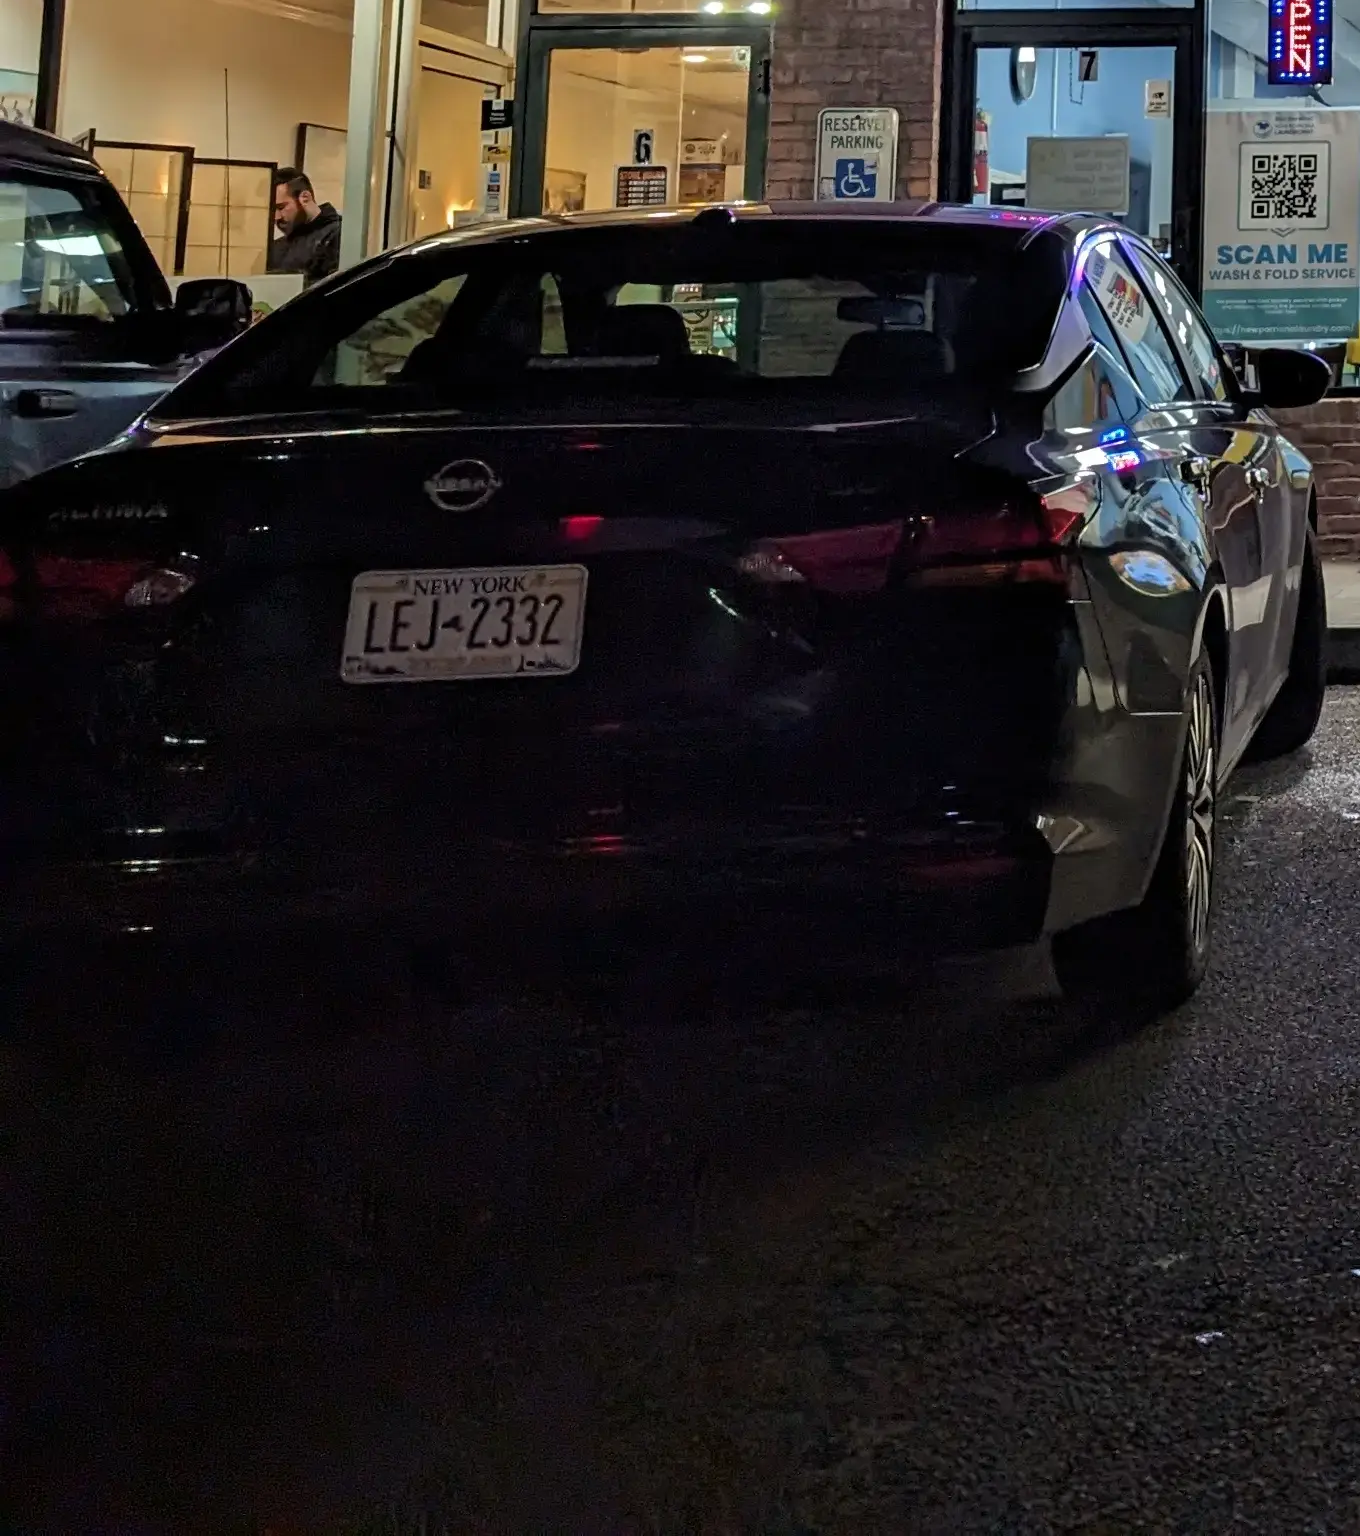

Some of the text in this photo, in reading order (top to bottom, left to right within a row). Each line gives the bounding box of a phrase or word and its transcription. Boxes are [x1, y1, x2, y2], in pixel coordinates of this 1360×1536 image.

[1081, 51, 1096, 81] 7
[635, 132, 652, 163] 6
[830, 134, 884, 150] PARKING
[1217, 243, 1348, 265] SCAN ME
[1209, 268, 1356, 280] WASH & FOLD SERVICE
[413, 576, 527, 596] NEW YORK
[364, 592, 564, 653] LEJ 2332
